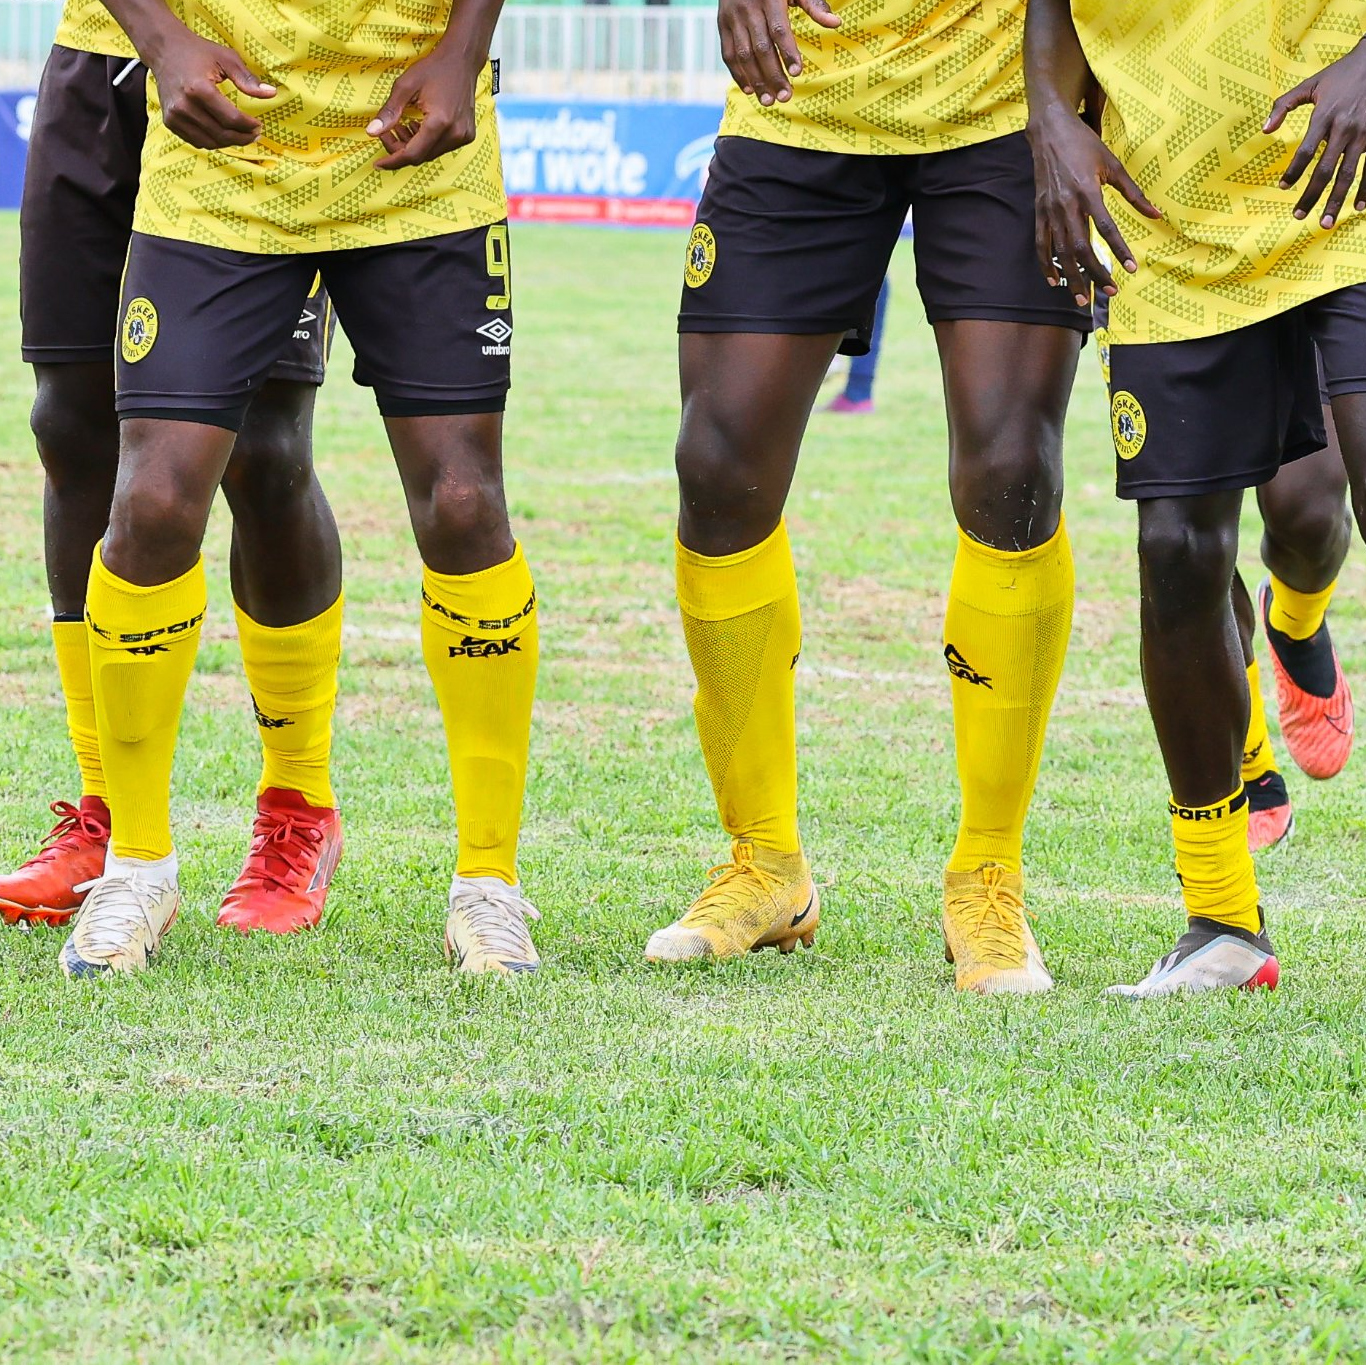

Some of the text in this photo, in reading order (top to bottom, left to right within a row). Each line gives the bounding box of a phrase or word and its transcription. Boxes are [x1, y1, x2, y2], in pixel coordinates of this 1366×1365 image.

[541, 143, 648, 195] wote
[485, 225, 511, 310] 9
[481, 343, 510, 356] umbro
[448, 637, 522, 658] PEAK
